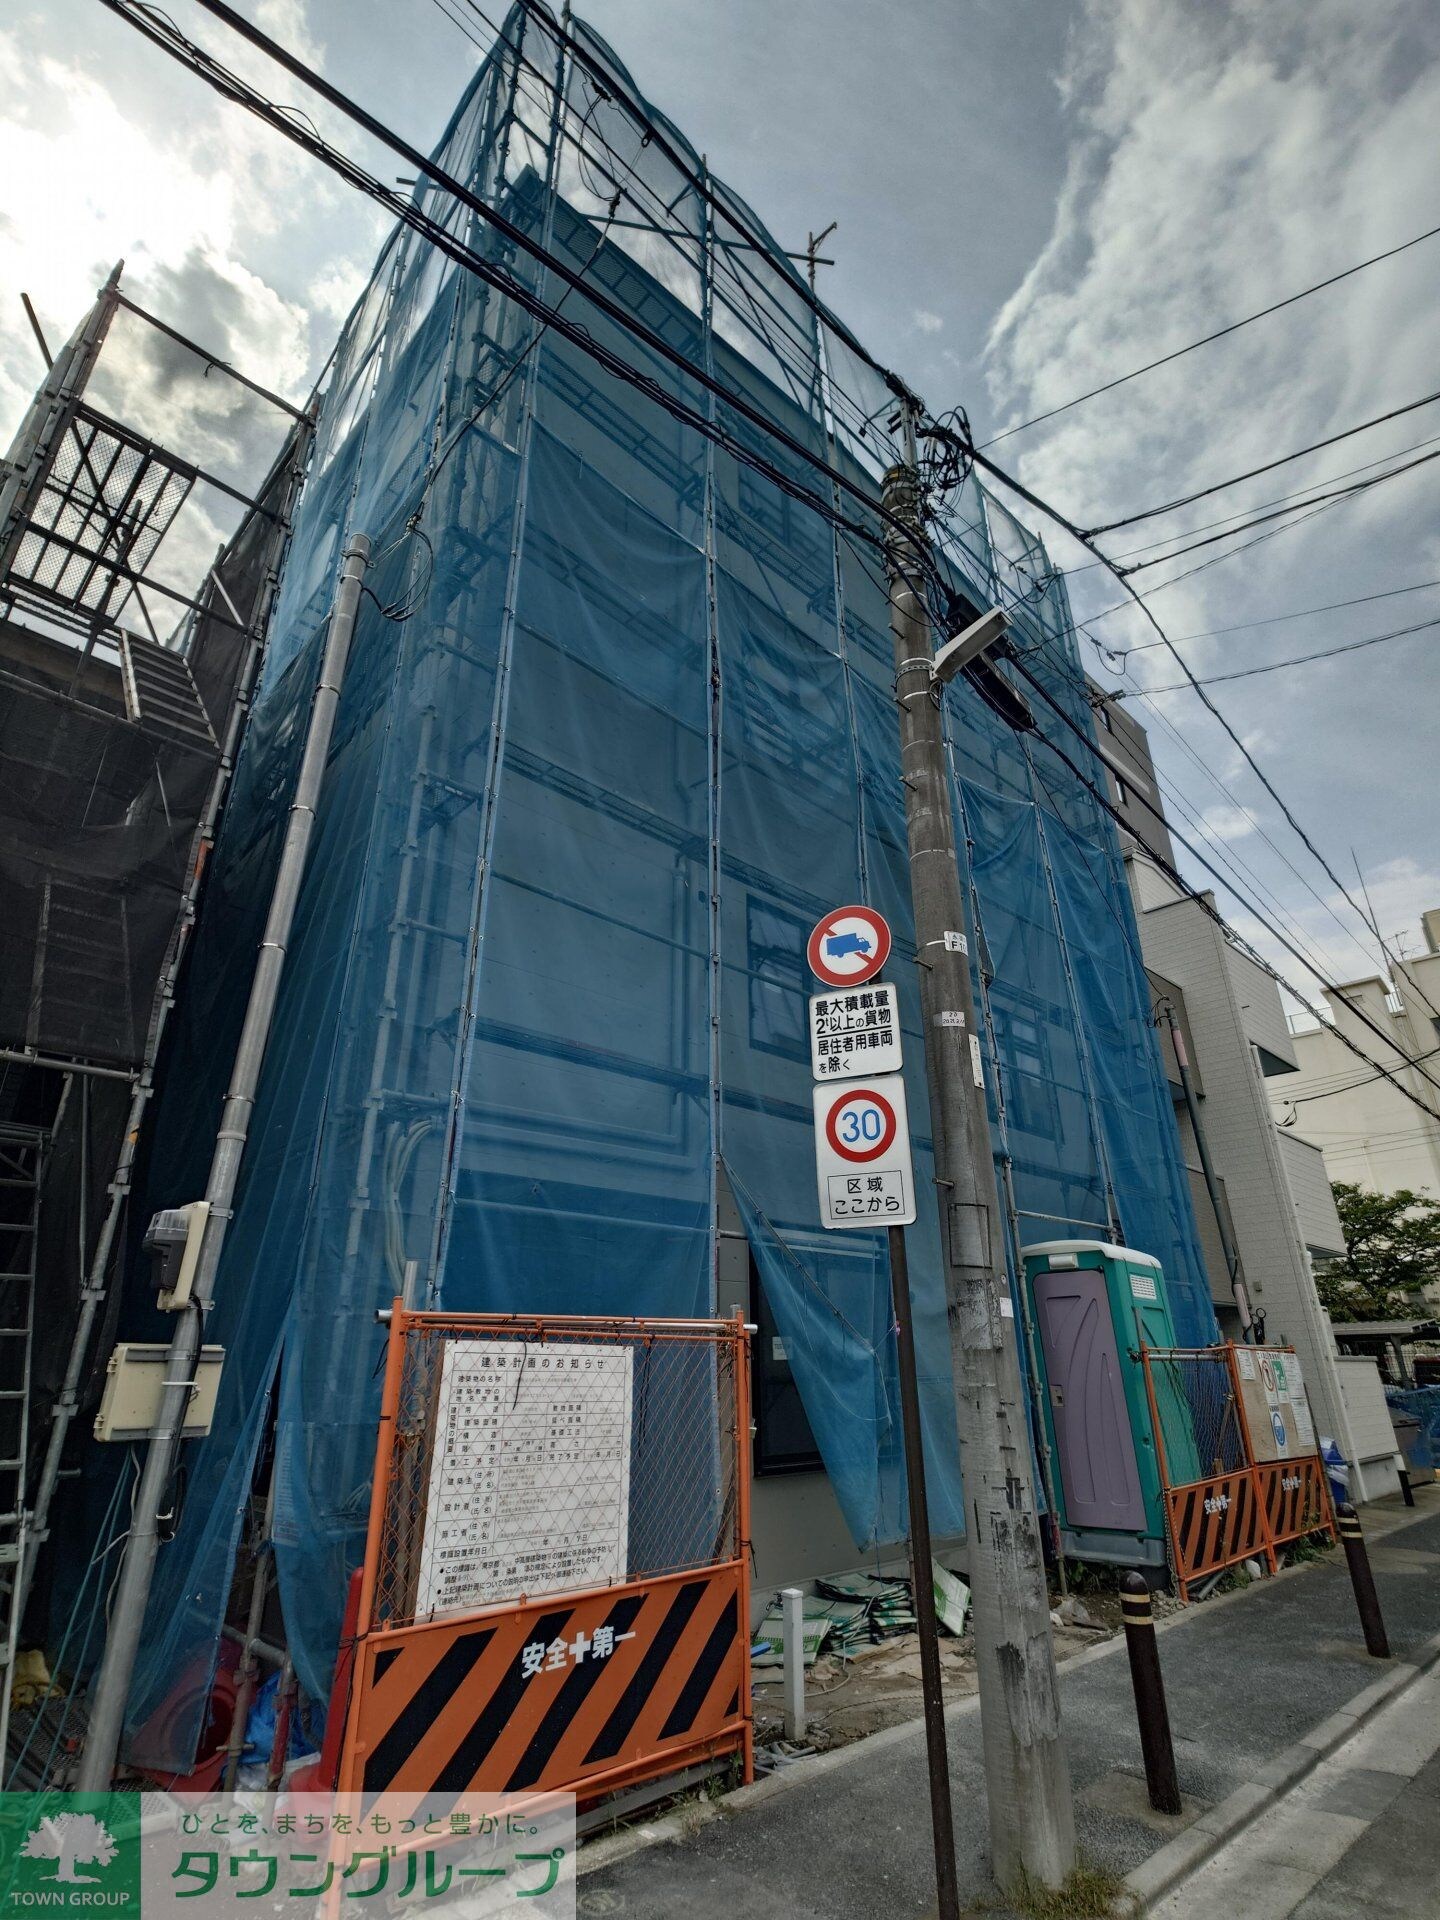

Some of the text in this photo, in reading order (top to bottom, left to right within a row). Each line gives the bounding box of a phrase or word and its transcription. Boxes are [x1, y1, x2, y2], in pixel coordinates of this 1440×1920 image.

[816, 990, 889, 1016] 最大積載量
[816, 1008, 891, 1035] 2t以上の貨物
[818, 1030, 893, 1056] 居住者用車両
[819, 1056, 850, 1074] を除く
[842, 1109, 881, 1143] 30
[847, 1177, 883, 1194] 区域
[835, 1195, 900, 1215] ここから
[480, 1356, 604, 1369] 建築計画のお知らせ
